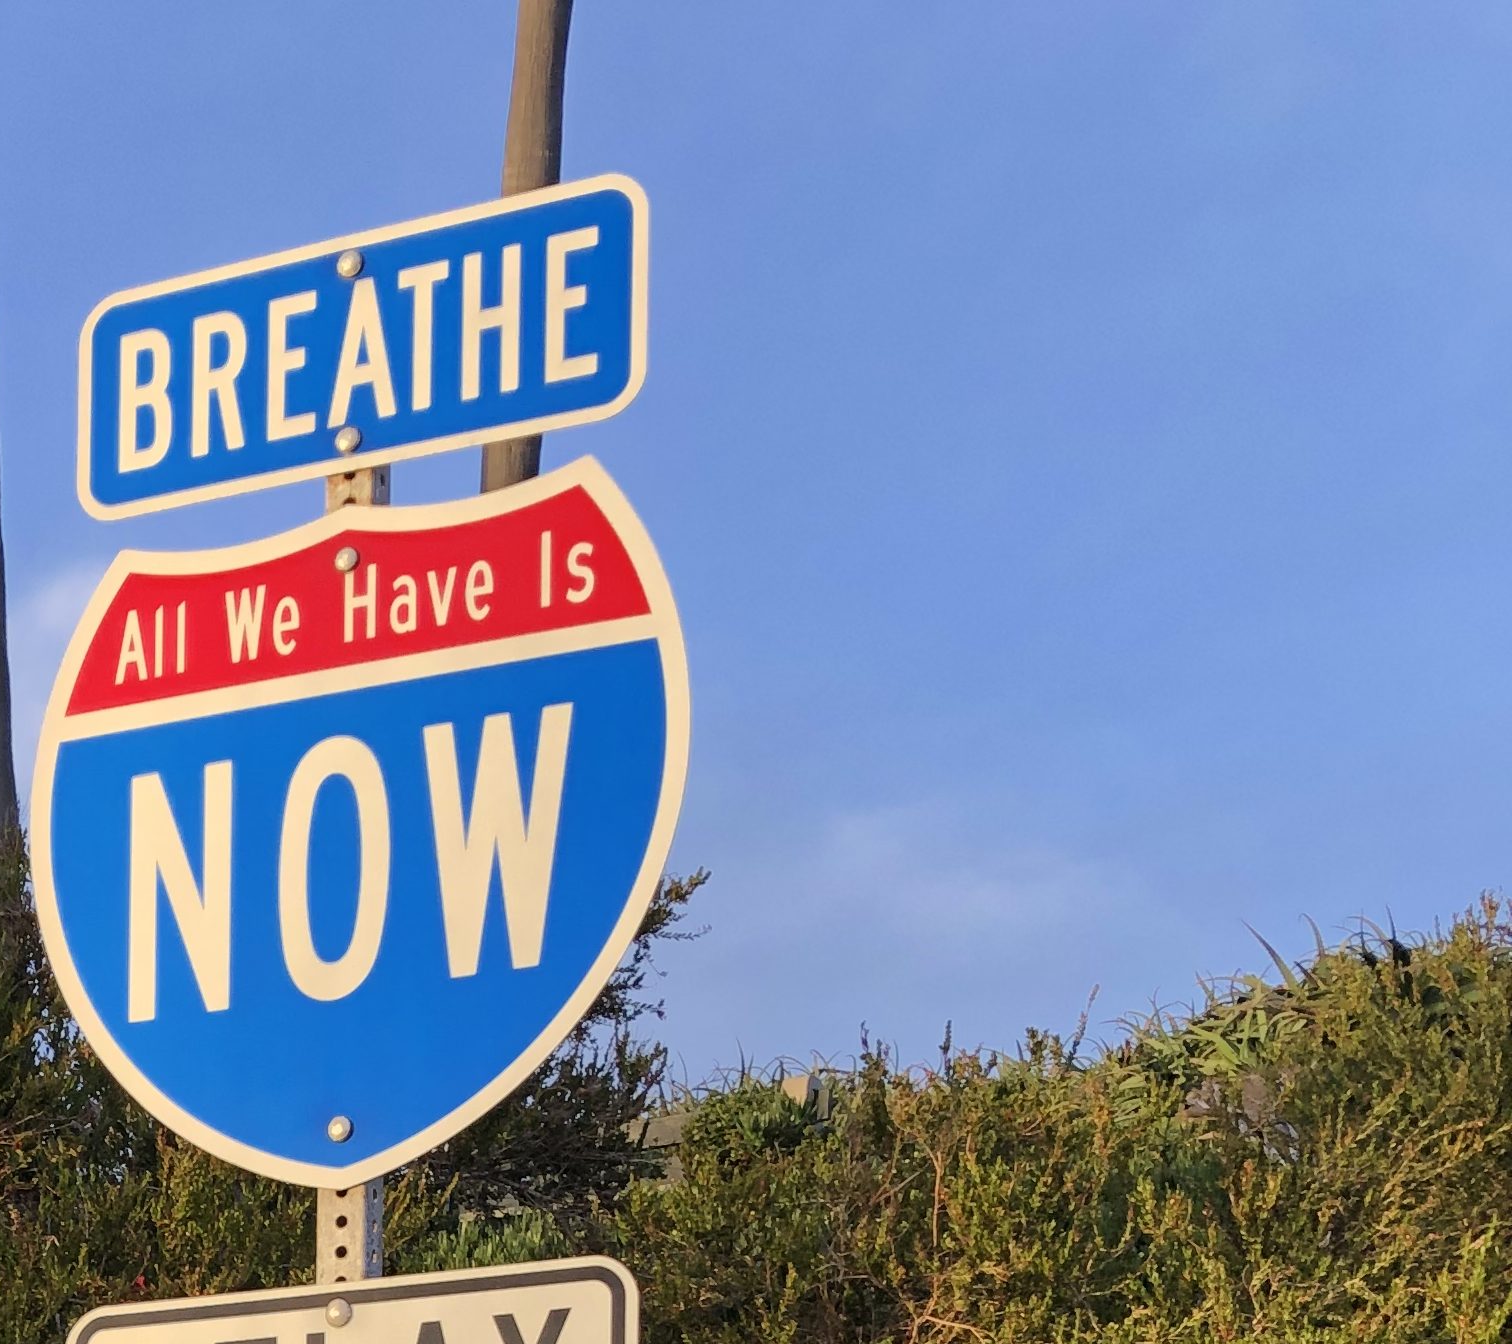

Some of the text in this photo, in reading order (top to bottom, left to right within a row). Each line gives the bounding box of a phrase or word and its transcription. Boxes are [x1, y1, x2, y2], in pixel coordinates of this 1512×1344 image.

[117, 225, 600, 475] BREATHE
[114, 530, 596, 687] All We Have Is
[127, 701, 575, 1024] NOW
